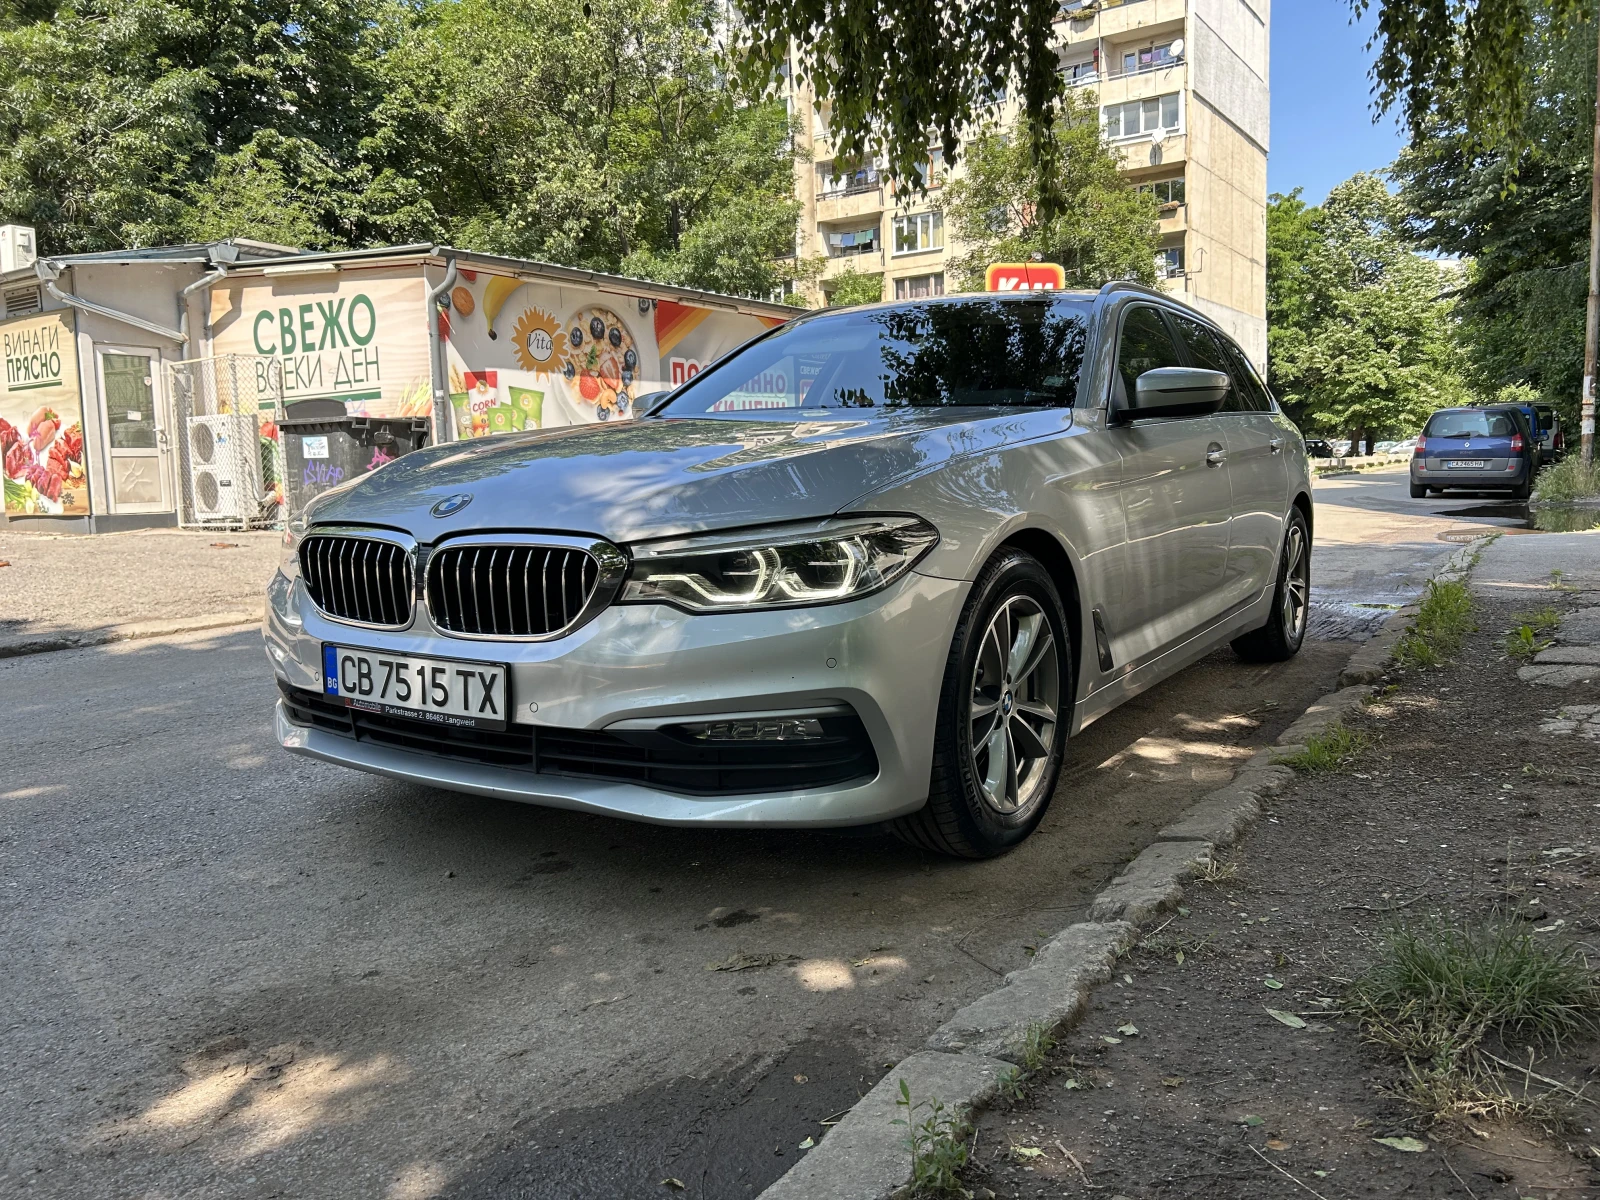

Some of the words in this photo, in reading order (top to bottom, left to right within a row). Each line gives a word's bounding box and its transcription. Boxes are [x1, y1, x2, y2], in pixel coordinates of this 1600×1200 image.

[253, 293, 376, 355] СВЕЖО
[4, 325, 59, 357] ВИНАГИ
[527, 333, 553, 350] Vita
[6, 351, 61, 383] ПРЯСНО
[334, 346, 380, 390] ДЕН
[472, 398, 496, 412] CORN
[327, 676, 338, 689] BG
[341, 655, 374, 696] CB
[378, 659, 450, 708] 7515
[455, 669, 498, 714] TX
[385, 706, 418, 717] Parkstrasse
[445, 715, 475, 727] Langweid
